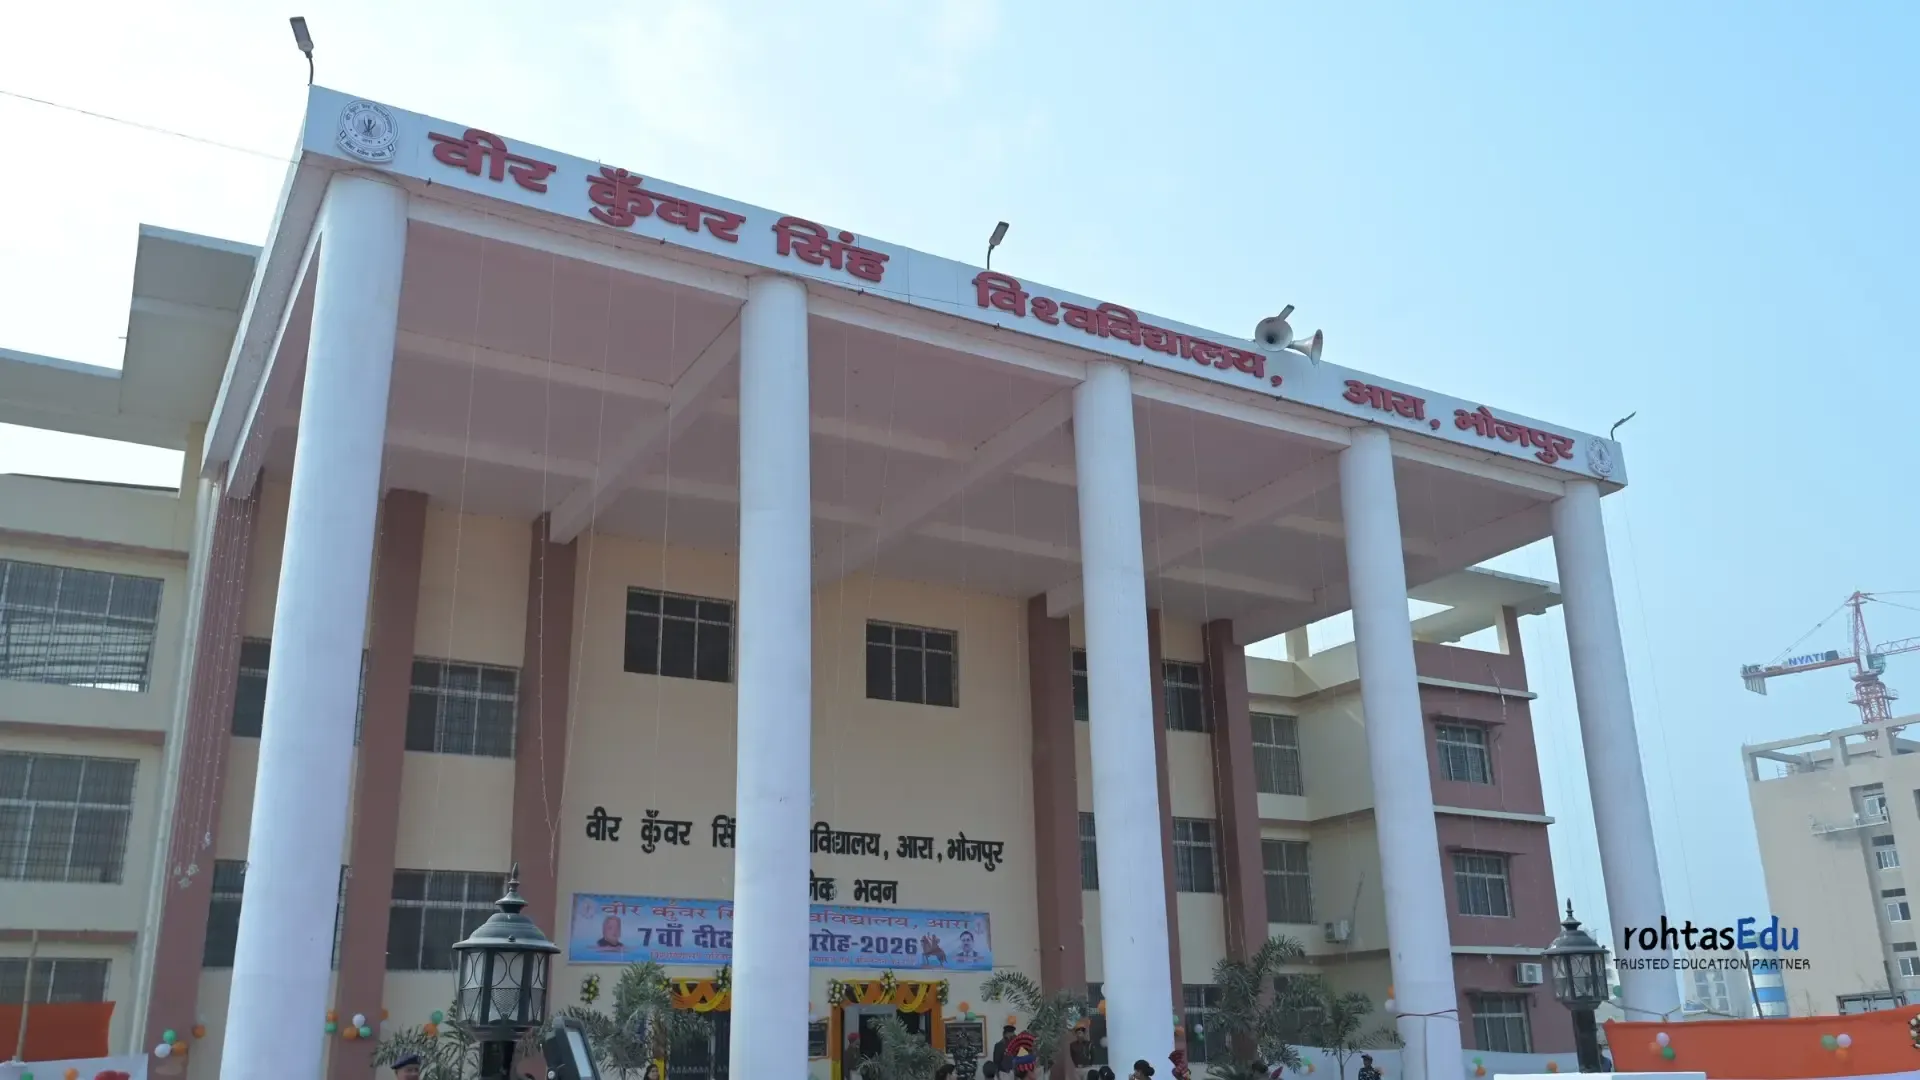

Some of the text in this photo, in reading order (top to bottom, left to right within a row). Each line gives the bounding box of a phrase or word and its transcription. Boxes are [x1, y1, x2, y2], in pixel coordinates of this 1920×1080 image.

[427, 127, 556, 193] वीर
[586, 166, 747, 243] कुँवर
[771, 216, 890, 283] सिंह
[972, 271, 1283, 387] विश्वविद्यालय,
[1343, 379, 1441, 431] आरा,
[1453, 406, 1575, 464] भोजपुर
[1788, 652, 1825, 666] NYATI
[586, 806, 623, 842] वीर
[641, 809, 693, 854] कुँवर
[947, 831, 1004, 872] भोजपुर
[854, 879, 899, 904] भवन
[602, 901, 643, 917] वीर
[926, 917, 972, 929] आरा
